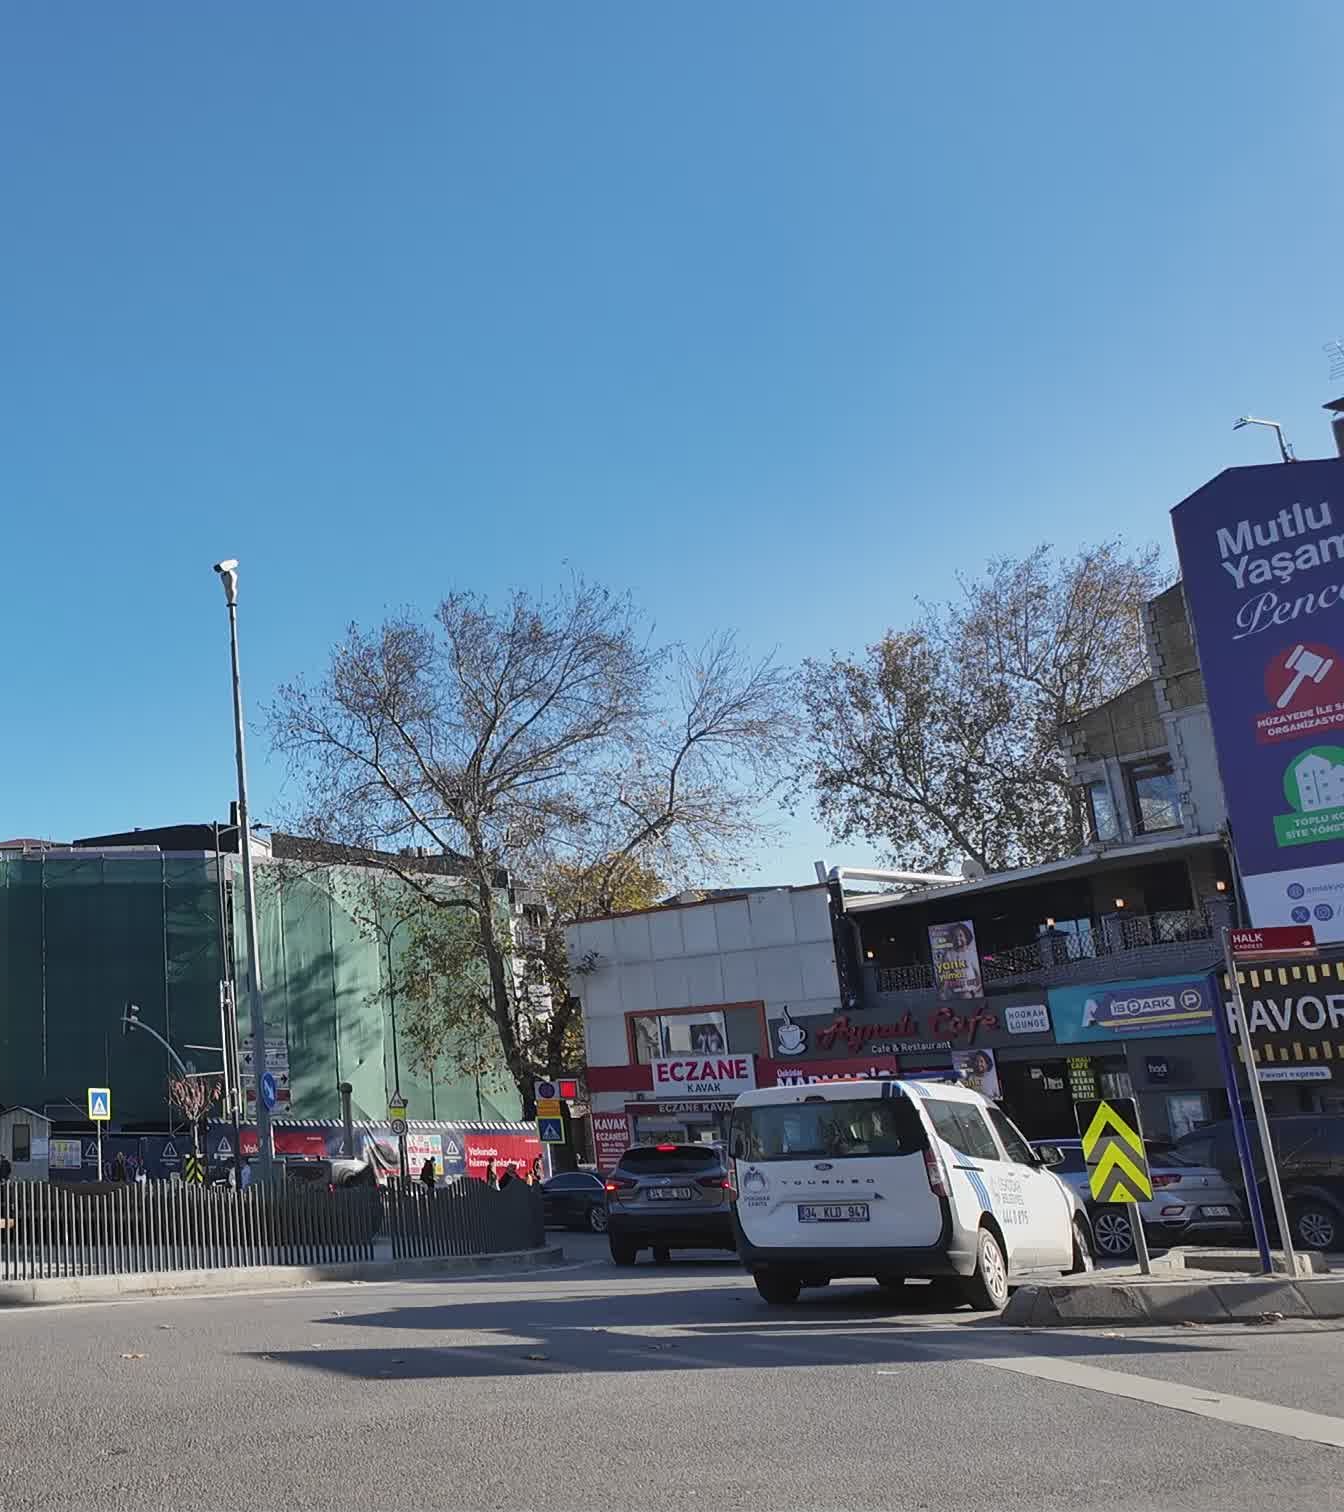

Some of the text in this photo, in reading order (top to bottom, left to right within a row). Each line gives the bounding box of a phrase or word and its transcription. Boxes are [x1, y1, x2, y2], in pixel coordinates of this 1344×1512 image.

[1216, 502, 1332, 559] Mutlu
[1232, 585, 1344, 640] Penc
[1257, 709, 1314, 728] MÜZAYEDE
[1232, 933, 1263, 943] HALK
[1010, 1019, 1045, 1030] LOUNGE
[901, 1041, 952, 1051] Restaurant
[657, 1058, 749, 1082] ECZANE
[687, 1083, 721, 1093] KAVAK
[659, 1104, 699, 1113] ECZANE
[594, 1118, 627, 1130] KAVAK
